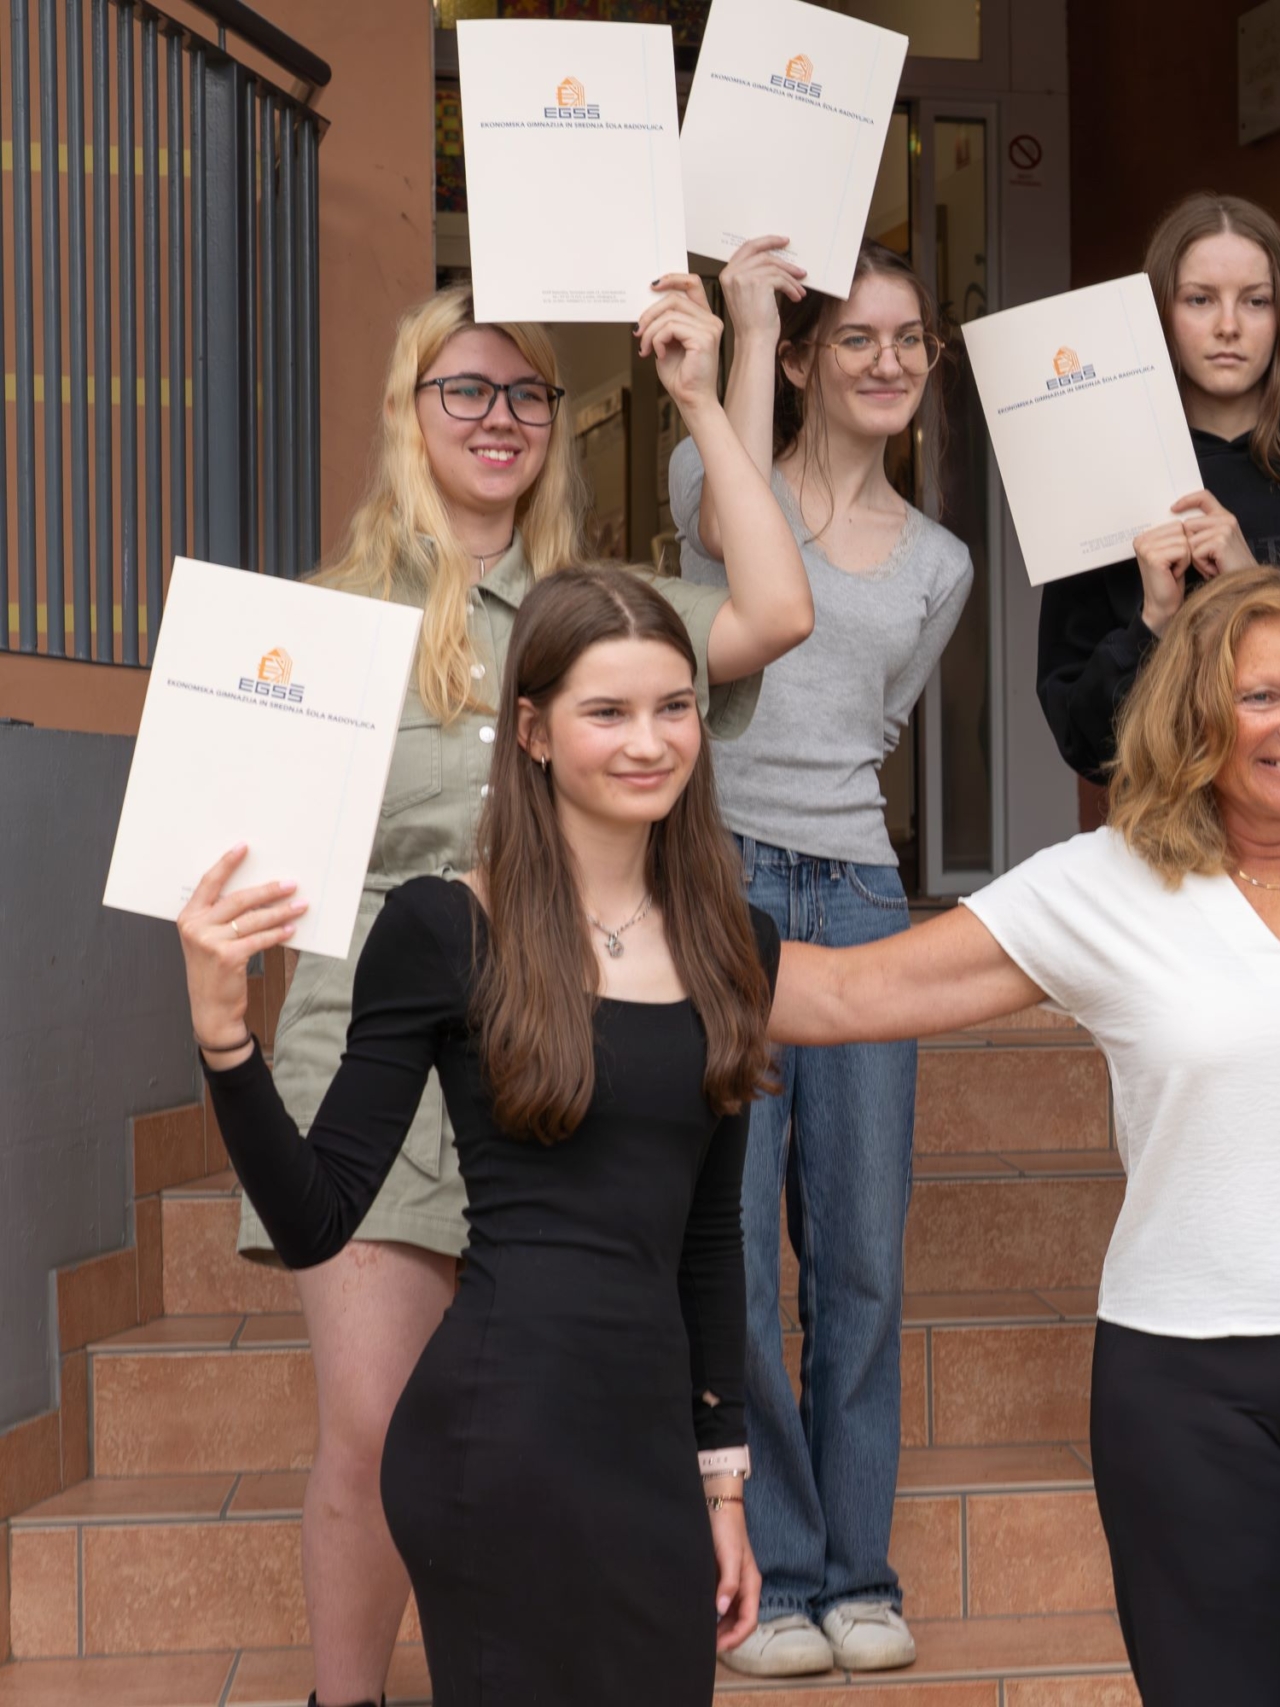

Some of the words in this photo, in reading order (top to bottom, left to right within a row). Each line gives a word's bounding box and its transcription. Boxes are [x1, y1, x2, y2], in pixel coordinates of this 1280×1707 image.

[167, 679, 214, 694] EKONOMSKA
[216, 691, 257, 704] GIMNAZIJA
[259, 699, 268, 707] IN
[270, 702, 303, 714] SREDNJA
[306, 708, 326, 719] ŠOLA
[327, 714, 375, 729] RADOVLJICA
